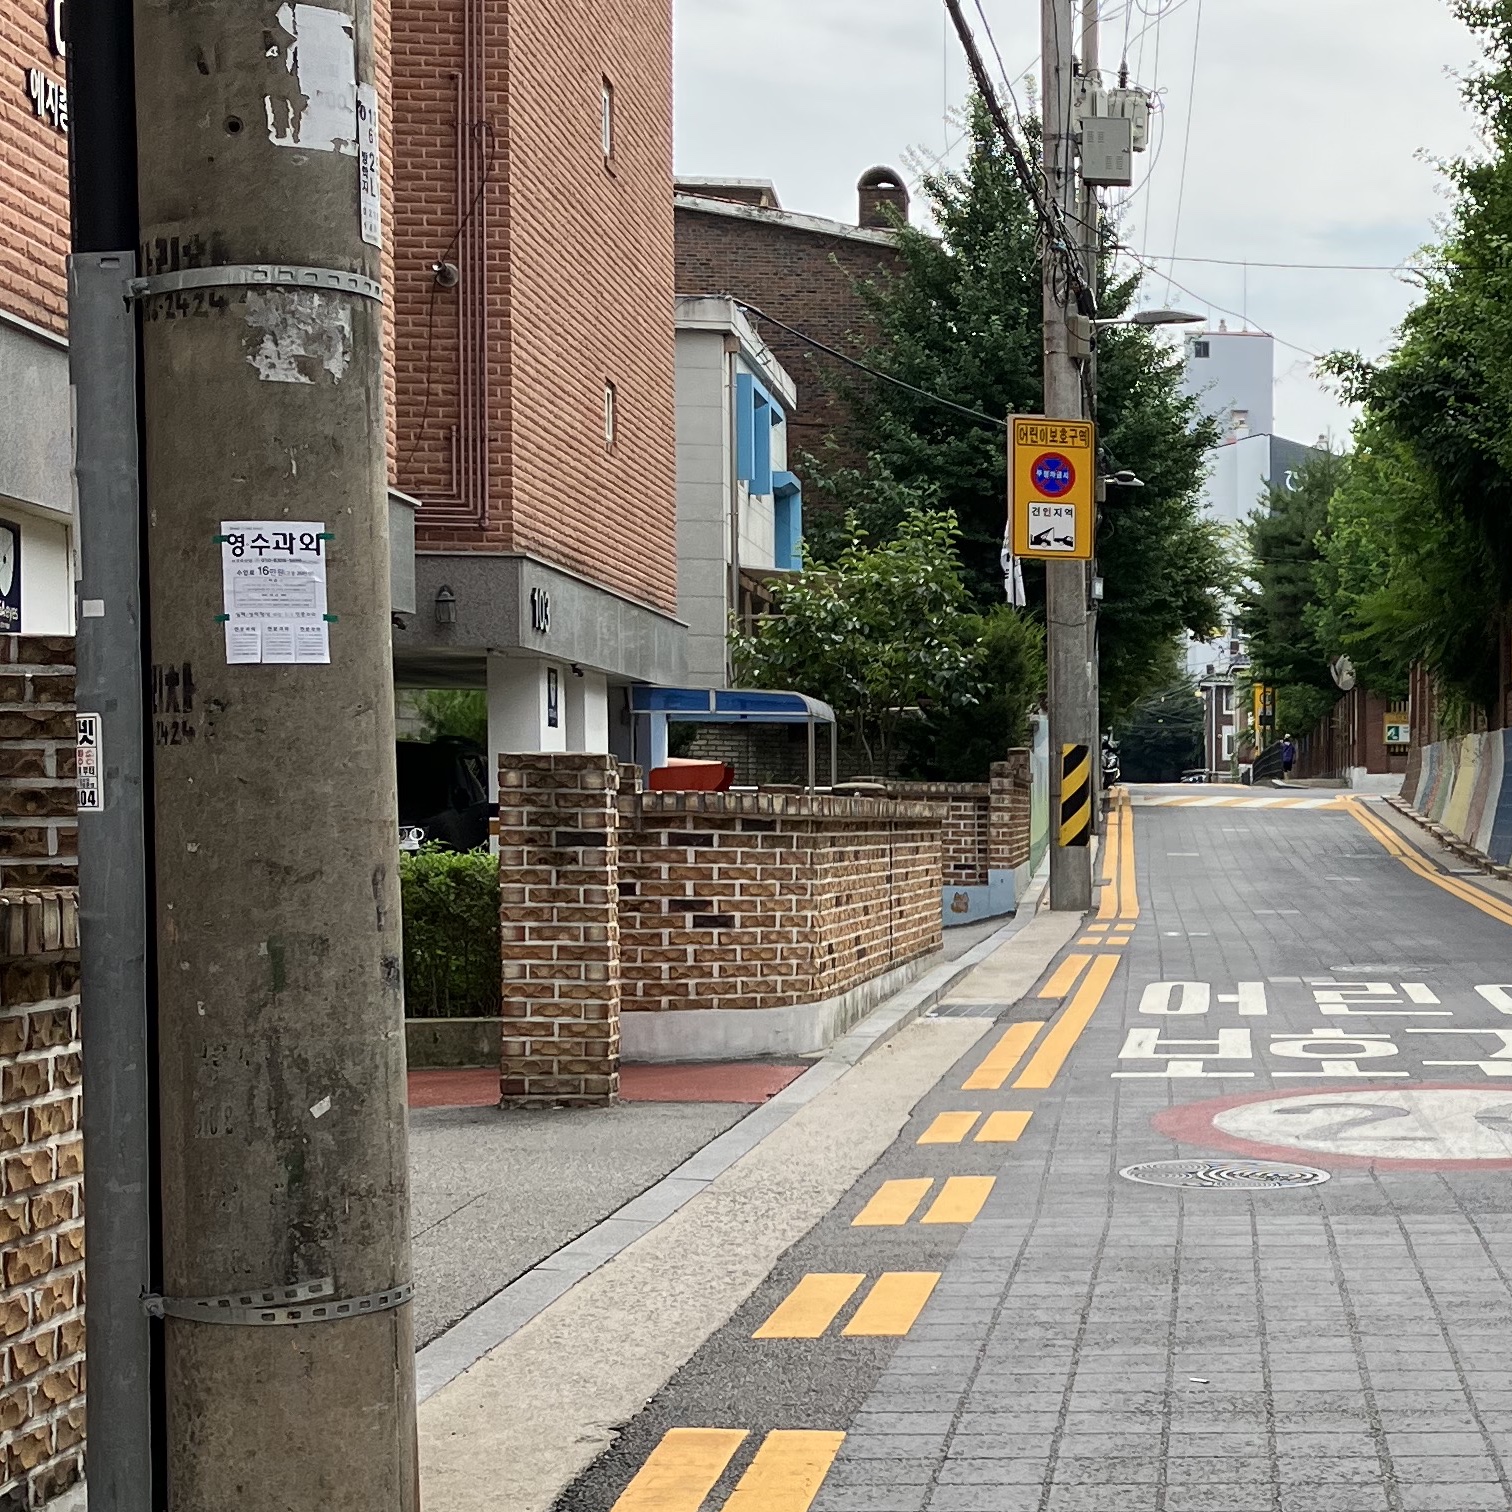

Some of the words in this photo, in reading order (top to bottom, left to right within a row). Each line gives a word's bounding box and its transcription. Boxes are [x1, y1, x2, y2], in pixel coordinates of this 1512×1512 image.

[1019, 426, 1088, 446] 어린이보호구역
[1031, 506, 1074, 519] 견인지역
[530, 587, 550, 634] 103
